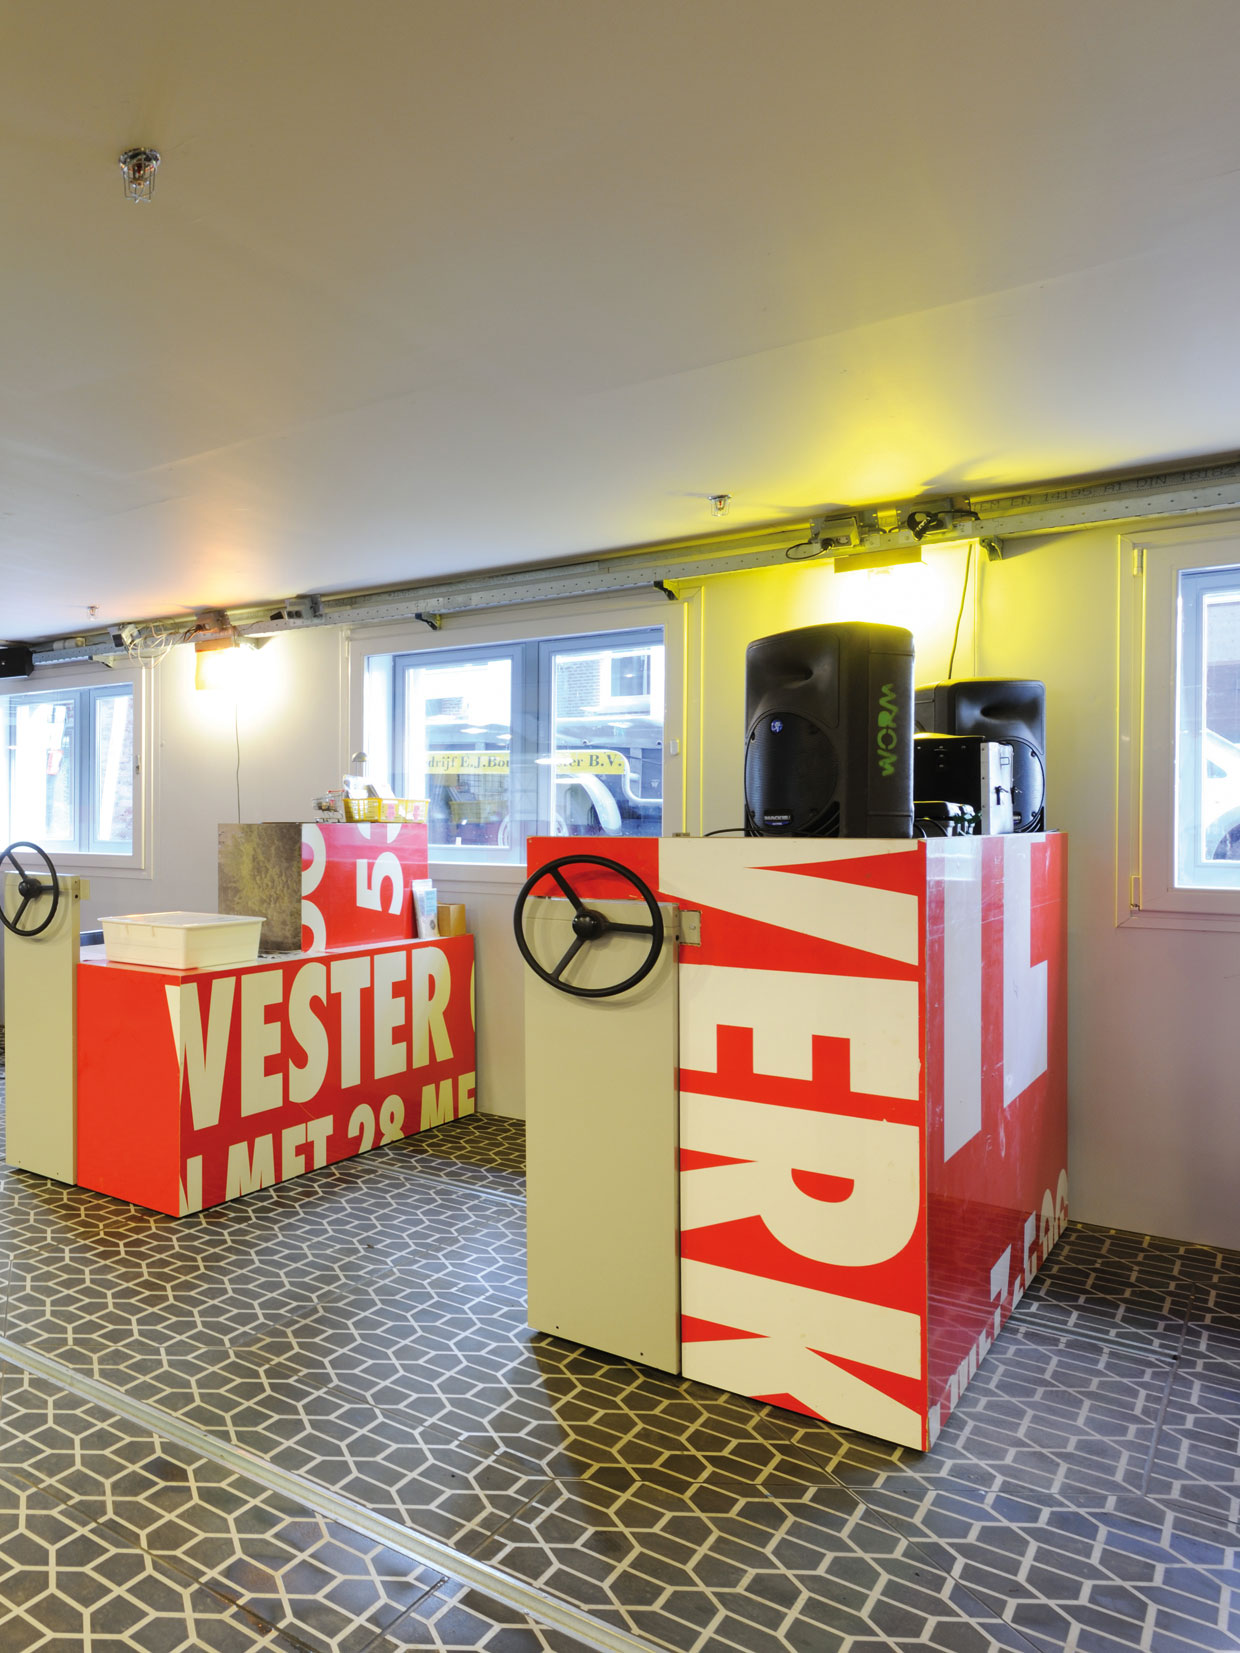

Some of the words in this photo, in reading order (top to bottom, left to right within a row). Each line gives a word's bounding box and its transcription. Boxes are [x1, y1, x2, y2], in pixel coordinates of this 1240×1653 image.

[589, 754, 623, 767] B.V.
[877, 684, 899, 777] WORM
[164, 946, 455, 1131] WESTER
[225, 1114, 333, 1201] MET
[348, 1094, 405, 1154] 28
